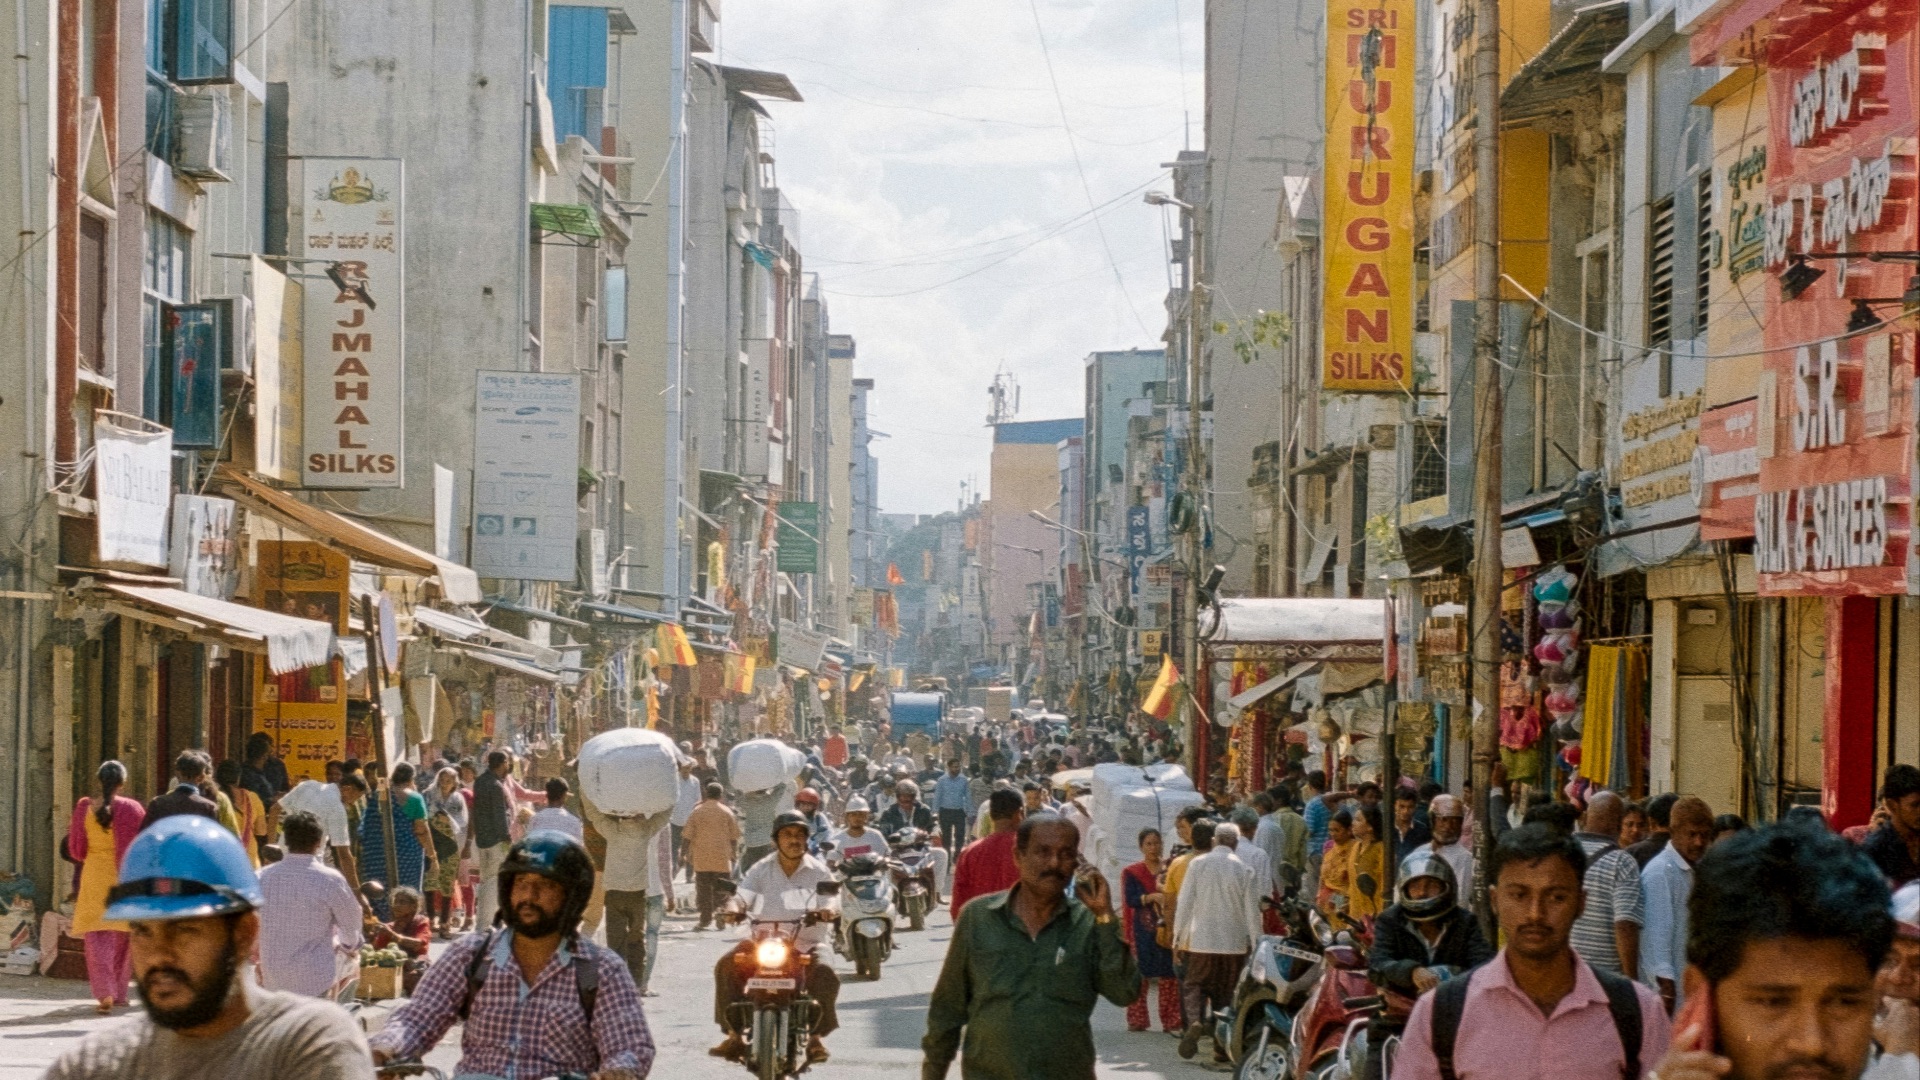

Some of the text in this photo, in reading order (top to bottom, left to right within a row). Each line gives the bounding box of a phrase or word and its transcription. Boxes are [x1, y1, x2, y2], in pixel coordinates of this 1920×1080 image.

[1347, 8, 1397, 30] SRI
[1331, 352, 1404, 381] SILKS
[308, 454, 395, 474] SILKS
[1754, 490, 1789, 573] SILK
[1813, 476, 1885, 571] SAREES
